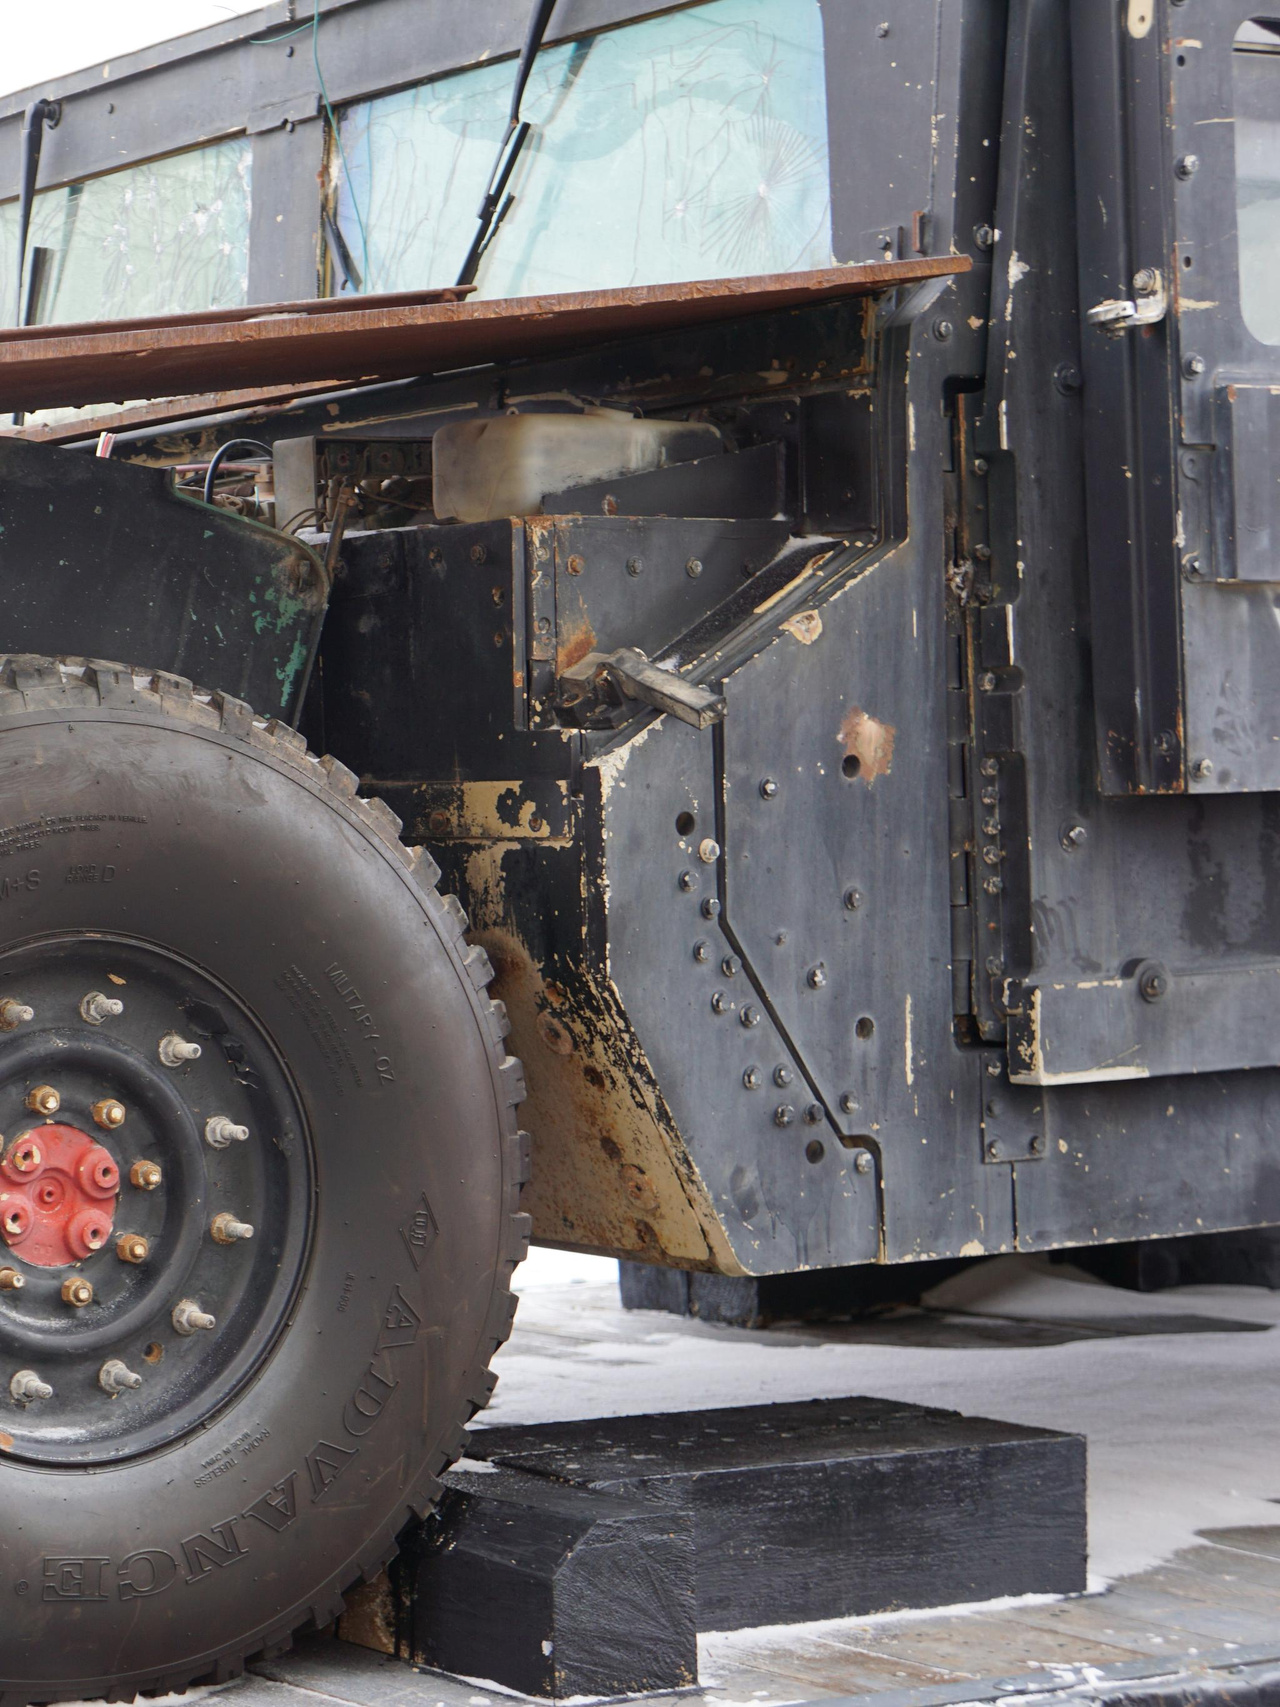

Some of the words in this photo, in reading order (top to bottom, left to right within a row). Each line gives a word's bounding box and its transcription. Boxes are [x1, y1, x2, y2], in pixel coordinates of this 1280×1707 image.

[325, 961, 380, 1039] MILITARY
[42, 1283, 421, 1602] ADVANCE
[221, 1444, 231, 1455] IN
[229, 1428, 250, 1447] MADE
[240, 1427, 271, 1457] RADIAL
[193, 1457, 238, 1489] TUBELESS
[200, 1450, 221, 1469] CHINA
